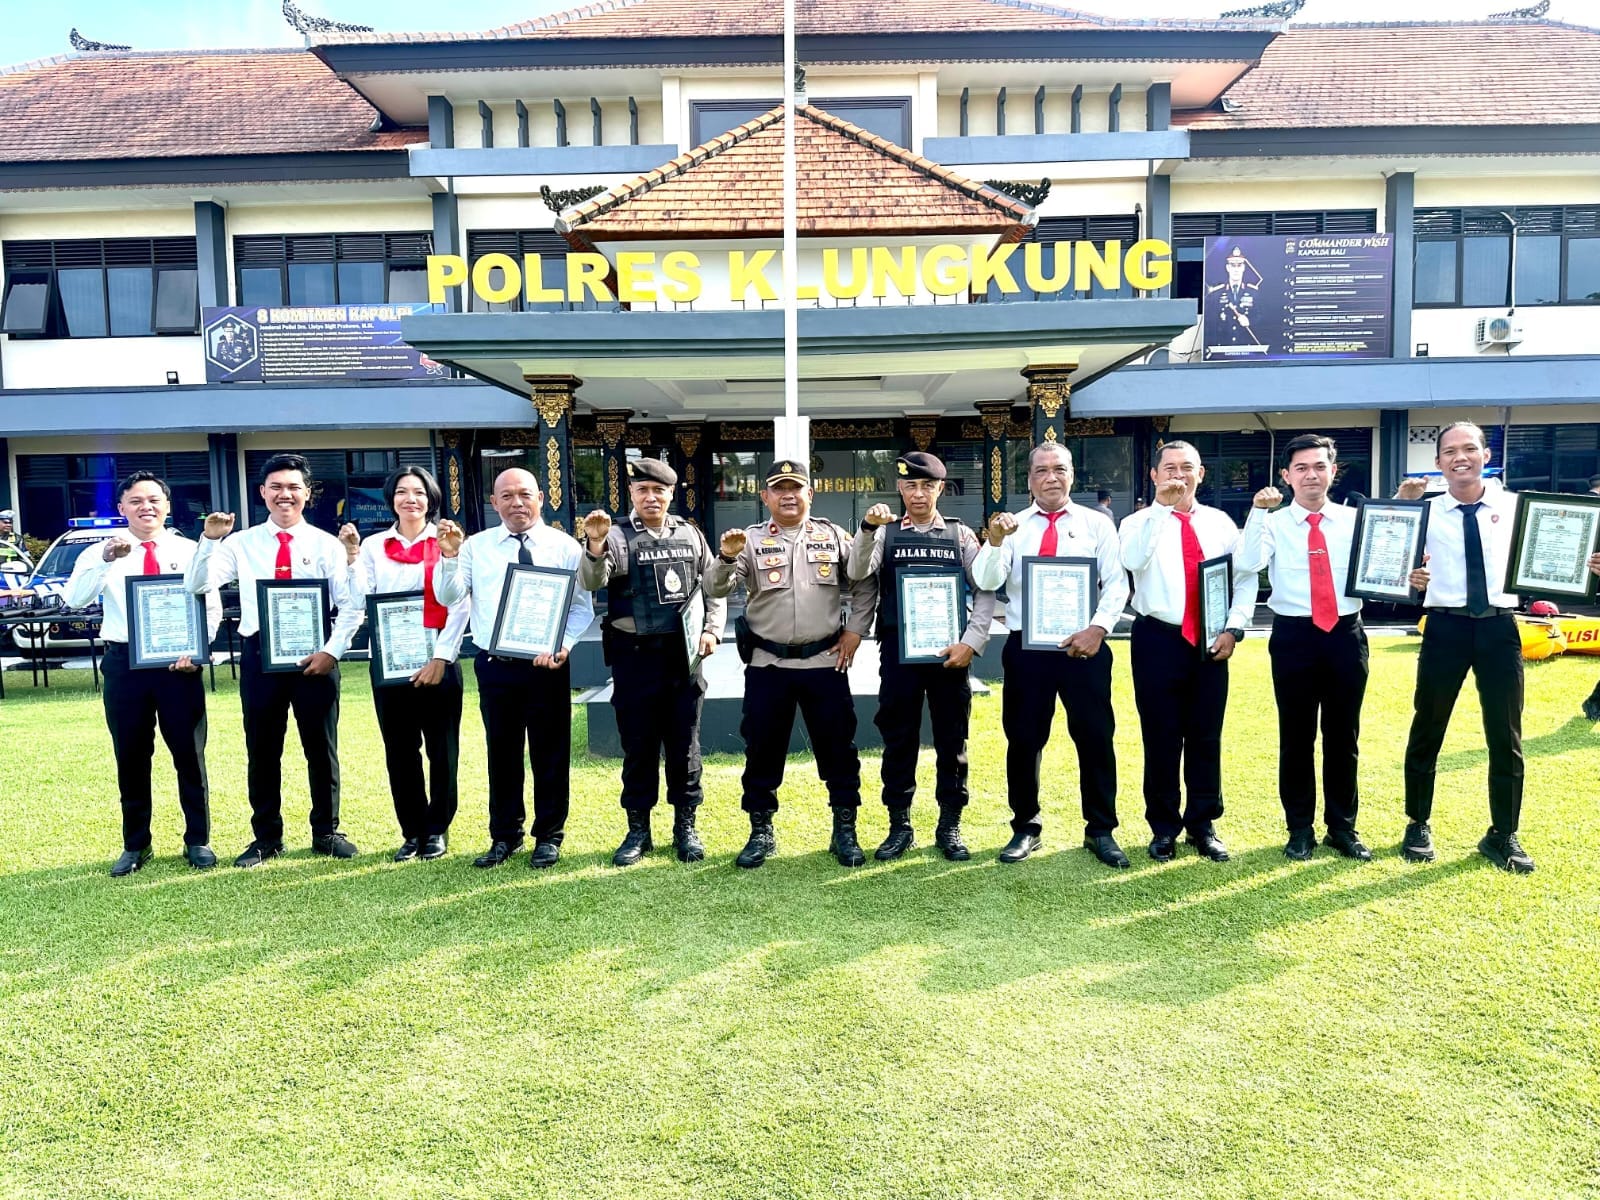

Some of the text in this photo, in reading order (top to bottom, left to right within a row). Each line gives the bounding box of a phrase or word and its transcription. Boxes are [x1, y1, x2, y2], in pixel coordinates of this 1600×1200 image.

[1298, 235, 1390, 248] COMMANDER WISH
[426, 250, 703, 303] POLRES
[256, 308, 268, 324] 8
[269, 307, 347, 323] KOMITMEN
[639, 548, 694, 561] JALAK NUSA
[894, 548, 955, 559] JALAK NUSA
